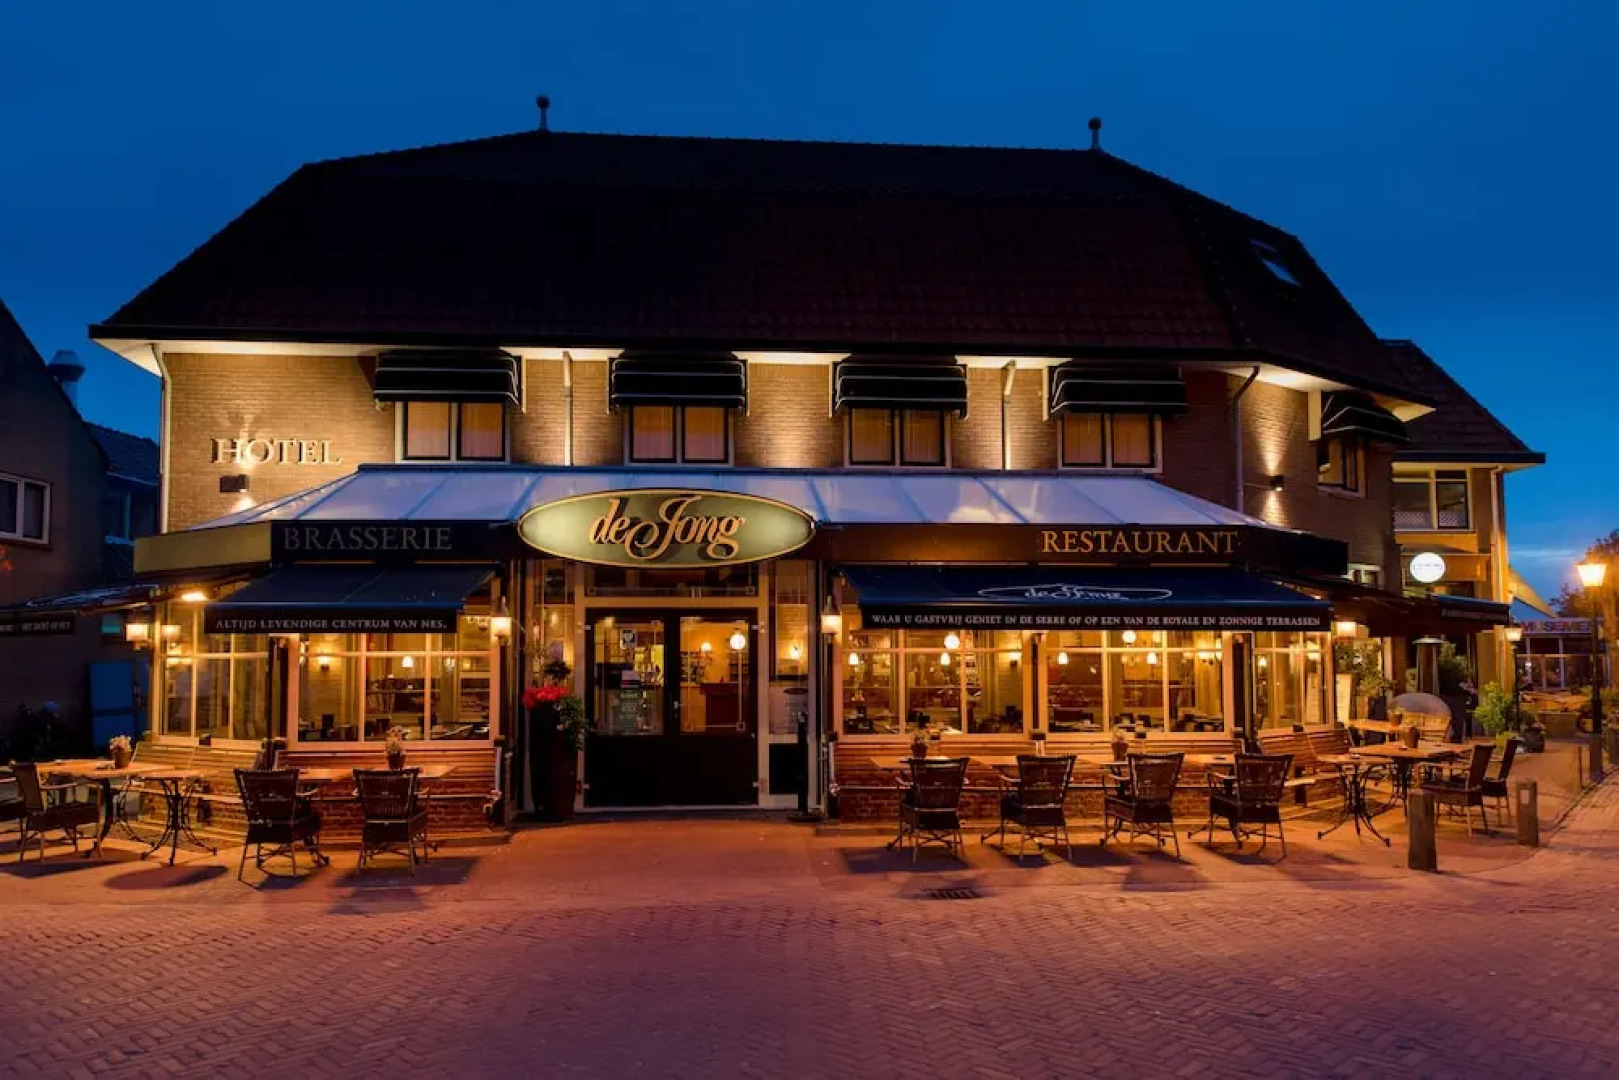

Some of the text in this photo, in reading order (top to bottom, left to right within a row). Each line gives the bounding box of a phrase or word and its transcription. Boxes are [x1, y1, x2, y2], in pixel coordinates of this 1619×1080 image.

[210, 438, 343, 465] HOTEL
[284, 526, 452, 550] BRASSERIE
[588, 494, 746, 559] de Jong
[1041, 530, 1238, 553] RESTAURANT
[216, 619, 447, 630] ALTIJD LEVENDIGE CENTRUM VAN NES.
[872, 614, 900, 623] WAAR
[904, 615, 912, 623] U
[914, 615, 962, 625] GASTVRIJ
[965, 615, 1001, 624] GENIET
[1020, 615, 1033, 624] DE
[1035, 615, 1065, 624] SERRE
[1068, 616, 1081, 625] OF
[1084, 616, 1098, 625] OP
[1101, 616, 1120, 625] EEN
[1123, 616, 1143, 625] VAN
[1147, 616, 1160, 625] DE
[1202, 616, 1216, 625] EN
[1219, 616, 1263, 625] ZONNIGE
[1266, 616, 1320, 626] TERRASSEN
